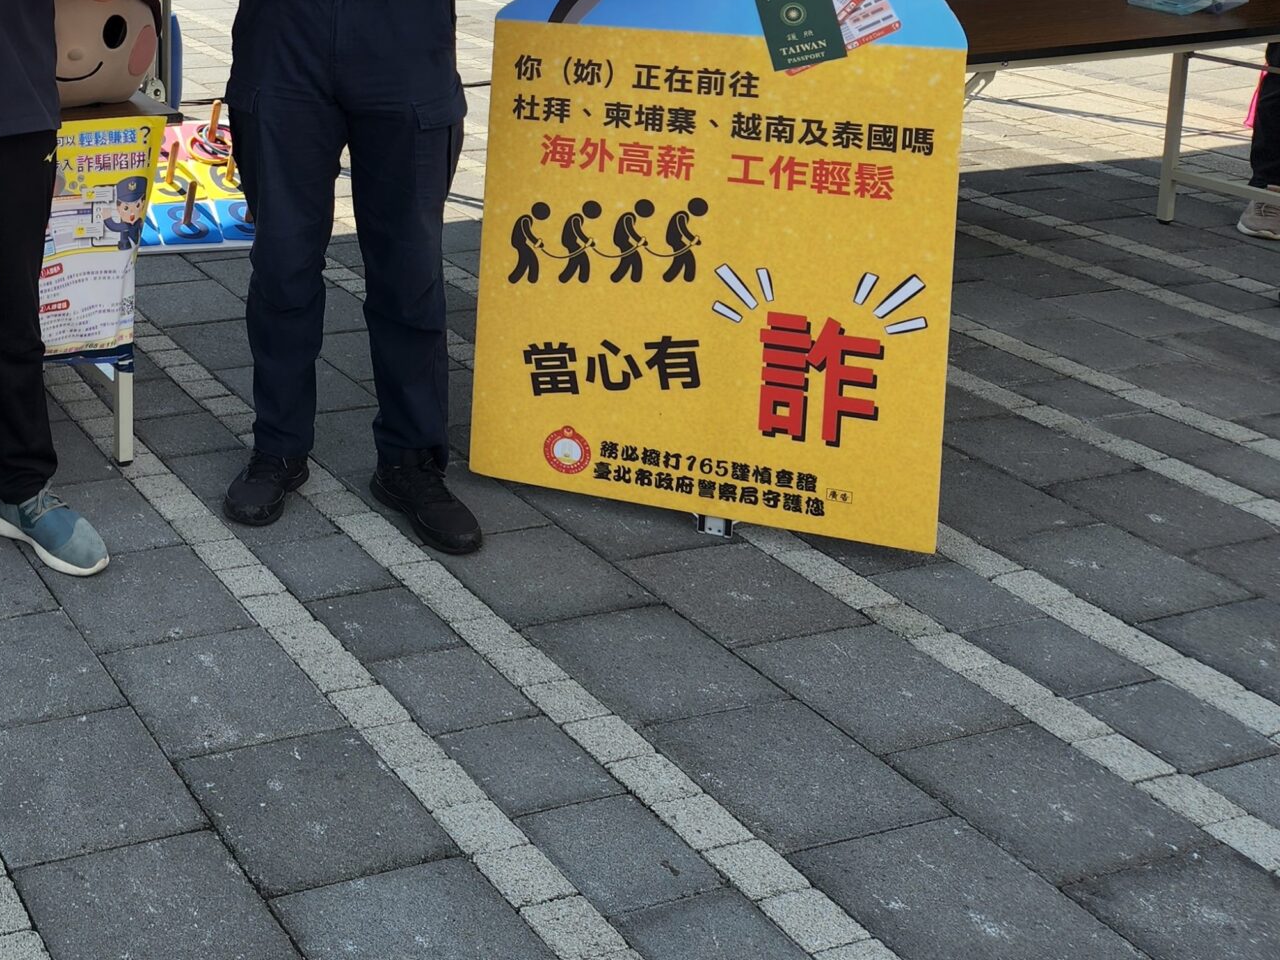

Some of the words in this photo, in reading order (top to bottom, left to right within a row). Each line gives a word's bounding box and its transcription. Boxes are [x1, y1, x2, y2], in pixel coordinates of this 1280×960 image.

[779, 40, 827, 56] TAIWAN
[787, 51, 825, 64] PASSPORT
[539, 133, 695, 182] 海外高薪
[726, 152, 895, 201] 工作輕鬆
[167, 205, 209, 239] 8
[522, 336, 702, 396] 當心有
[758, 310, 885, 448] 詐
